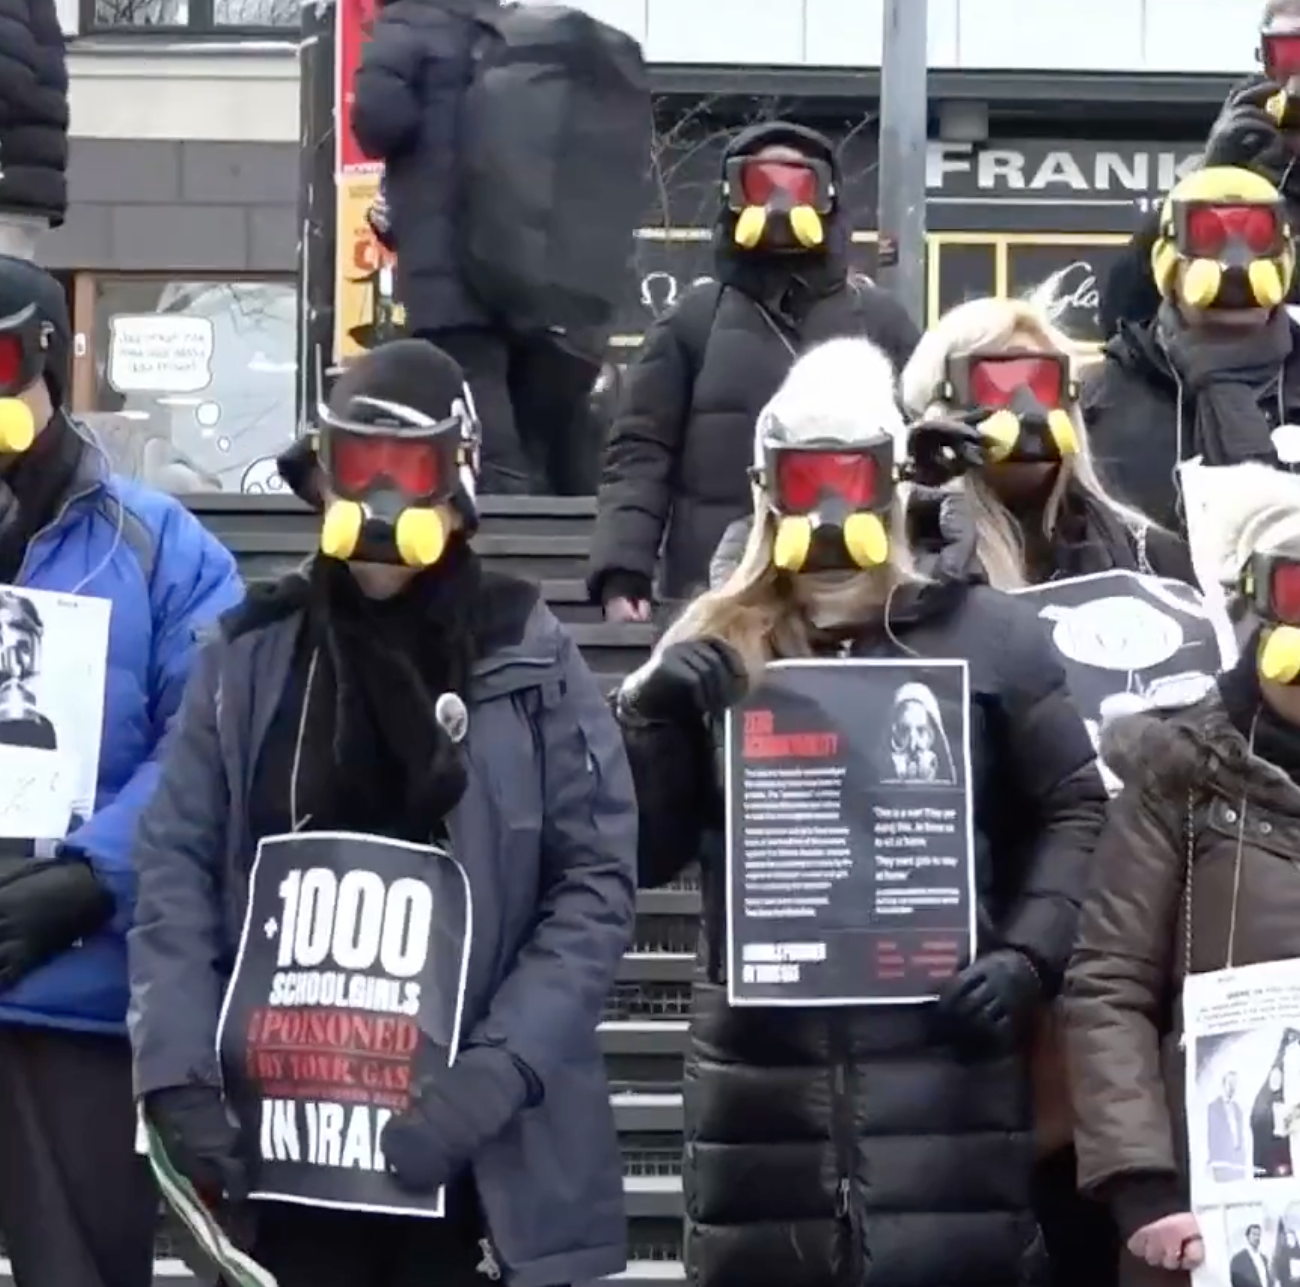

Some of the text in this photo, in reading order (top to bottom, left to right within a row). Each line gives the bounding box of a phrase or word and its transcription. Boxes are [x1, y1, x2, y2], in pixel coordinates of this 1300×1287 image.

[269, 970, 421, 1016] SCHOOLGIRLS
[261, 1008, 419, 1054] POISONED
[361, 1060, 411, 1091] GAS
[260, 1097, 301, 1162] IN
